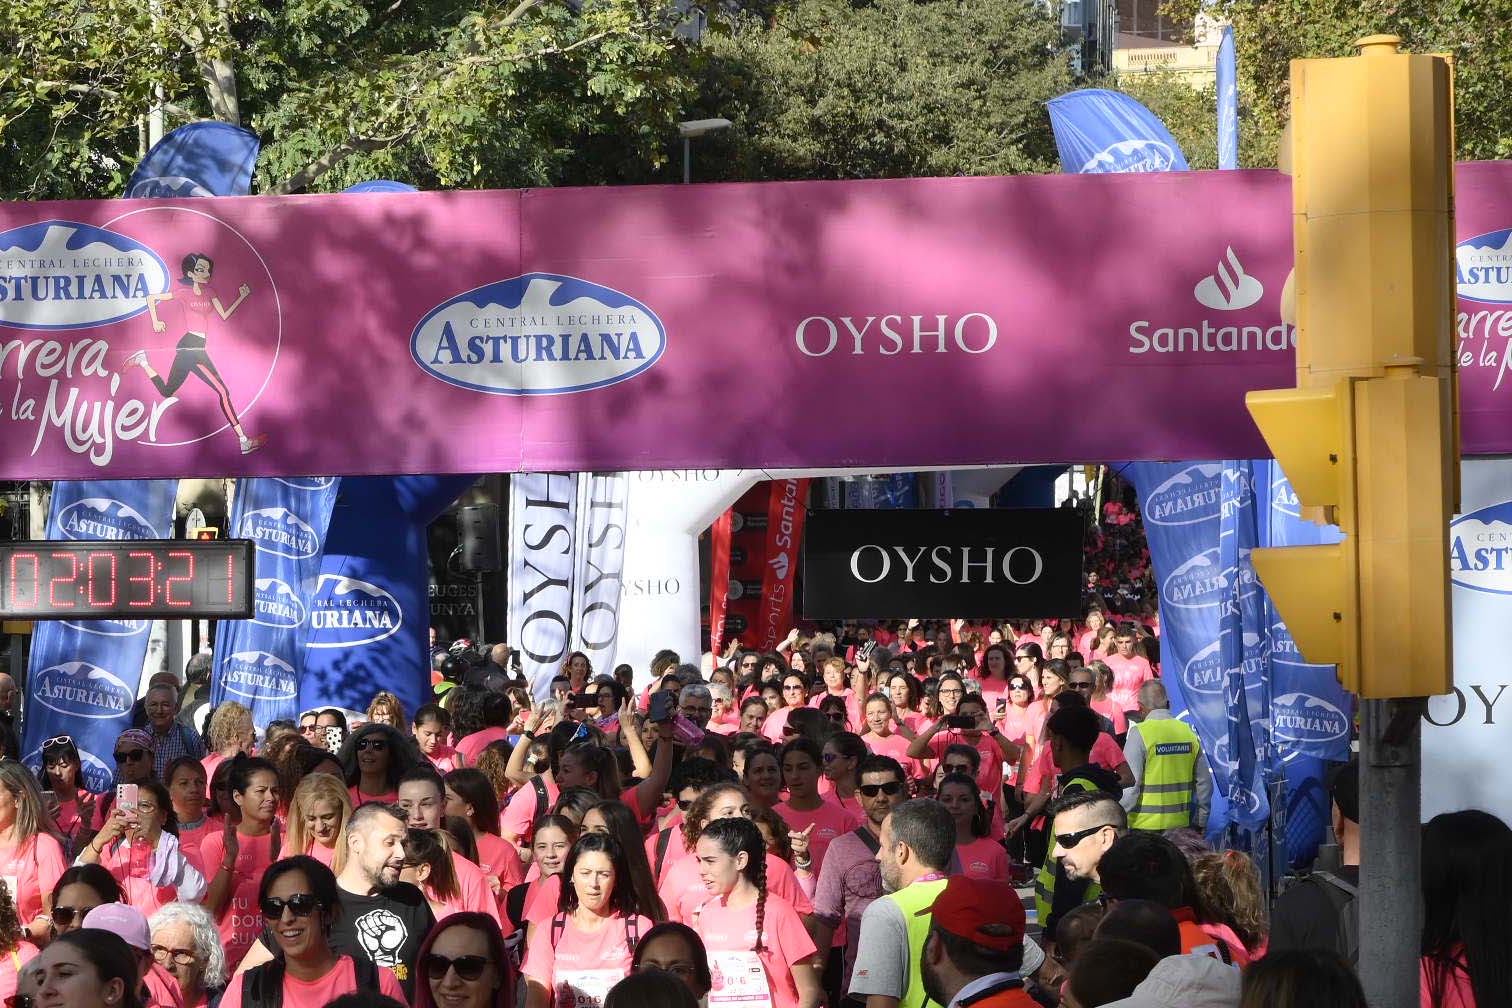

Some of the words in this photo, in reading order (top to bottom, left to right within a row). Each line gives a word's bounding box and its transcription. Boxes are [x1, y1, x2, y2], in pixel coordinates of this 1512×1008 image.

[73, 256, 145, 269] LECHERA
[469, 315, 549, 330] CENTRAL
[555, 313, 638, 327] LECHERA
[795, 312, 998, 357] OYSHO
[430, 319, 646, 366] ASTURIANA
[1479, 339, 1497, 367] la
[11, 379, 36, 421] la
[31, 373, 179, 466] Mujer
[240, 518, 313, 554] ASTURIANA
[10, 551, 234, 608] 02:03:21
[850, 544, 1044, 585] OYSHO
[37, 677, 126, 711] ASTURIANA
[231, 897, 248, 910] TU
